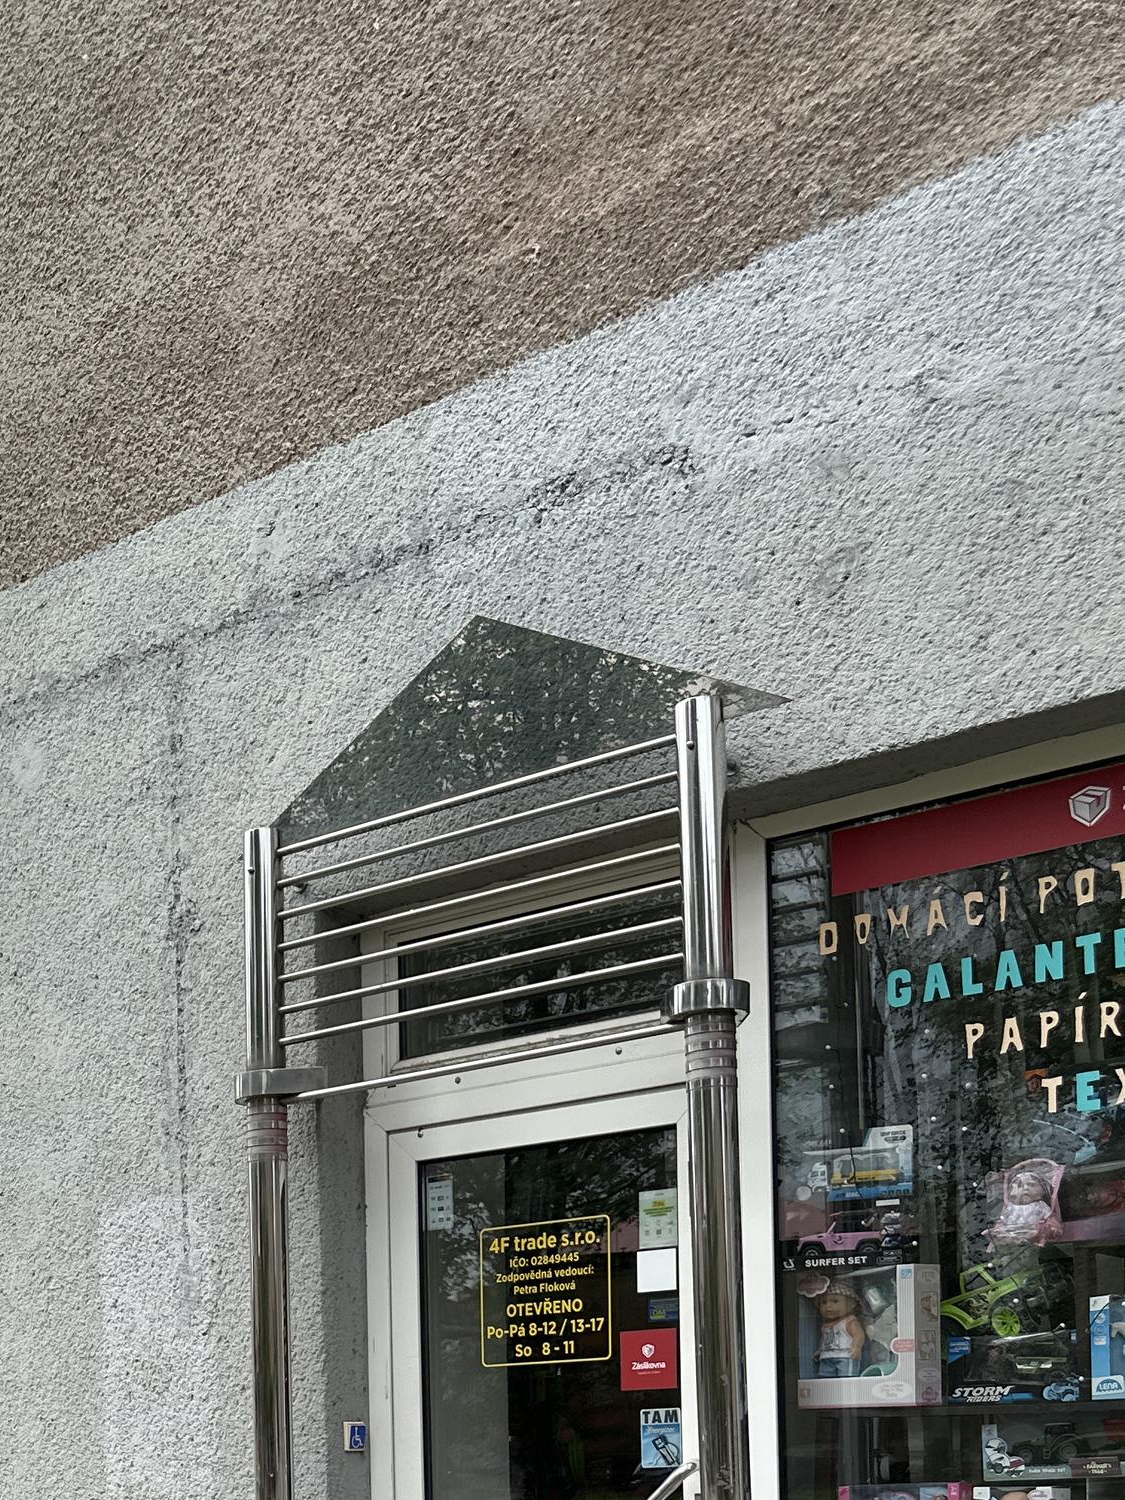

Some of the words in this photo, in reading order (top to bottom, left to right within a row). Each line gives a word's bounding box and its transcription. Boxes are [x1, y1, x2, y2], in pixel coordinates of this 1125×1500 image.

[819, 870, 1010, 956] DOMÁCÍ
[964, 991, 1122, 1060] PAPÍR
[489, 1237, 510, 1254] 4F
[514, 1232, 557, 1252] trade
[561, 1230, 601, 1247] s.r.o.
[509, 1256, 529, 1268] IČO:
[530, 1251, 580, 1266] 02849445
[804, 1257, 845, 1268] SURFER
[848, 1255, 868, 1266] SET
[496, 1268, 553, 1284] Zodpovědná
[554, 1263, 595, 1279] vedoucí:
[513, 1284, 538, 1296] Petra
[539, 1280, 576, 1293] Floková
[506, 1297, 583, 1318] OTEVŘENO
[487, 1322, 526, 1339] Po-Pá
[528, 1321, 557, 1336] 8-12
[559, 1318, 568, 1336] /
[570, 1317, 605, 1333] 13-17
[515, 1343, 533, 1357] So
[541, 1342, 551, 1356] 8
[563, 1340, 575, 1354] 11
[952, 1385, 1016, 1398] STORM
[1098, 1382, 1120, 1391] LENA
[966, 1394, 1003, 1403] RIDERS
[642, 1410, 679, 1424] TAM
